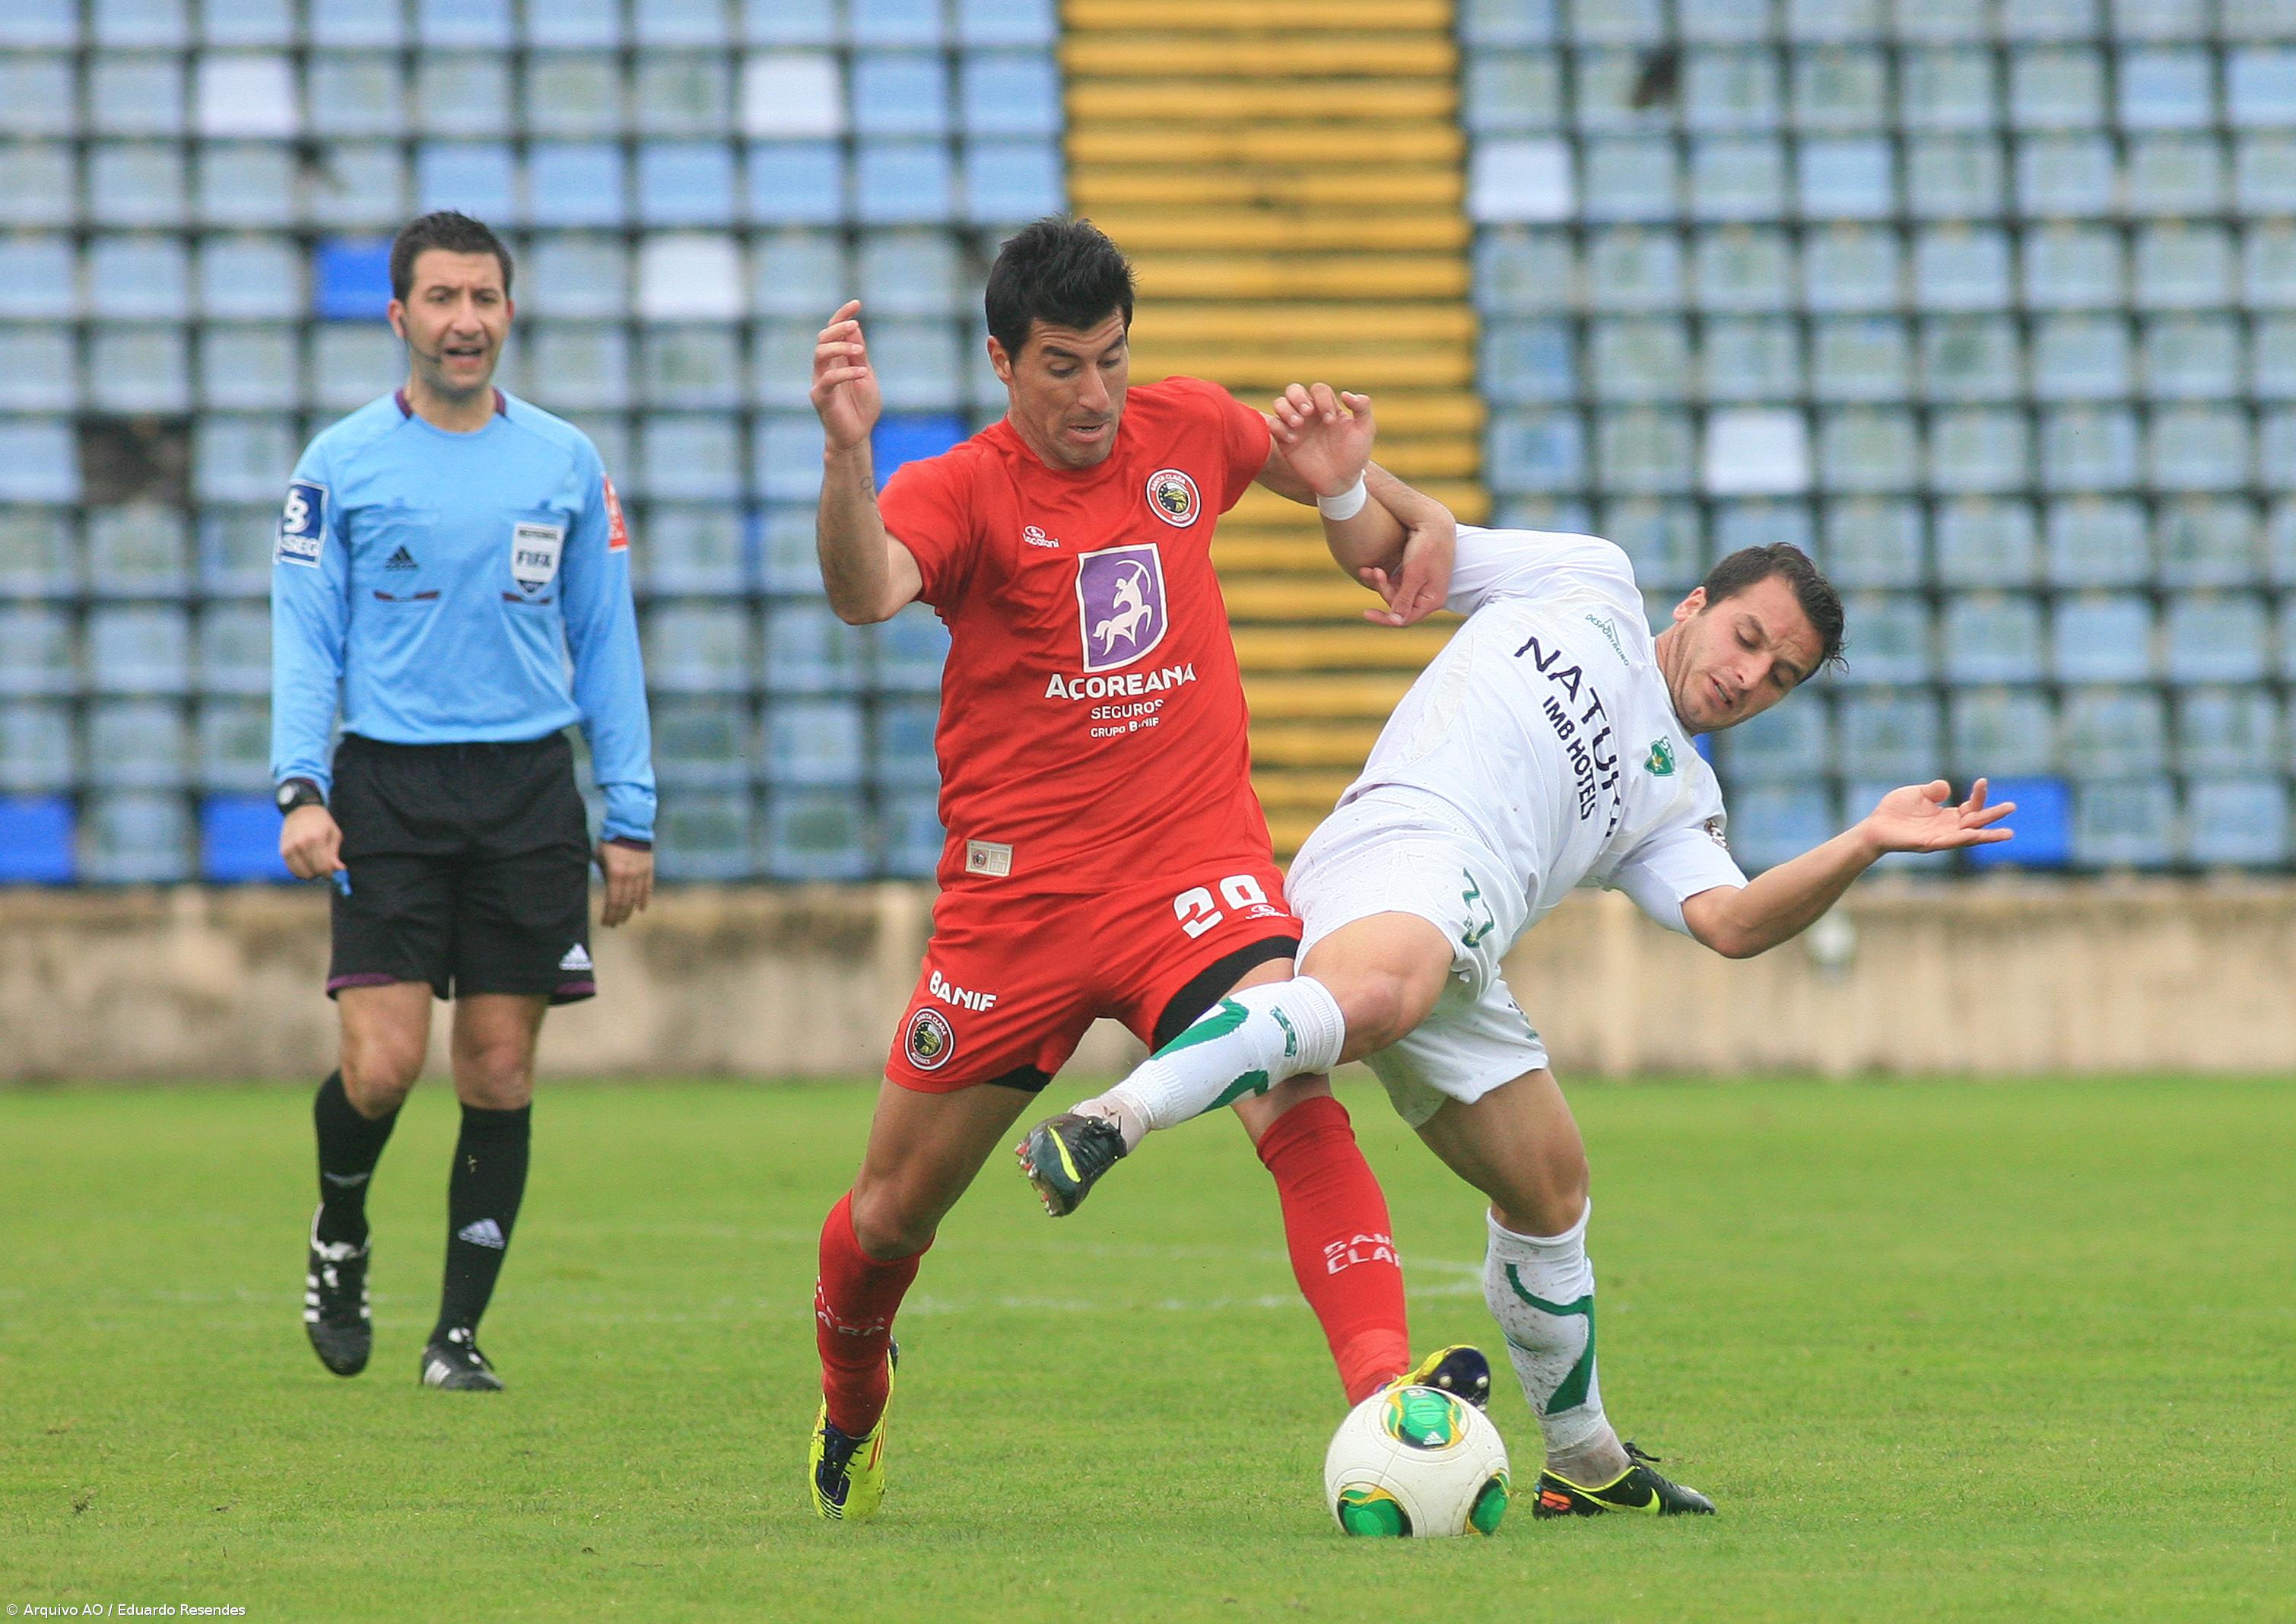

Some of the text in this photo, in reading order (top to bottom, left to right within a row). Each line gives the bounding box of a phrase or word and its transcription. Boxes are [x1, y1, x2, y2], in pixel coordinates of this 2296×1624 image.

[517, 549, 552, 568] FIFA
[1044, 663, 1197, 701] AÇOREANA
[1090, 698, 1164, 720] SEGUROS
[1090, 717, 1160, 738] GRUPO BNIF
[1542, 695, 1597, 821] IMB HOTELS
[929, 970, 998, 1012] BANIF
